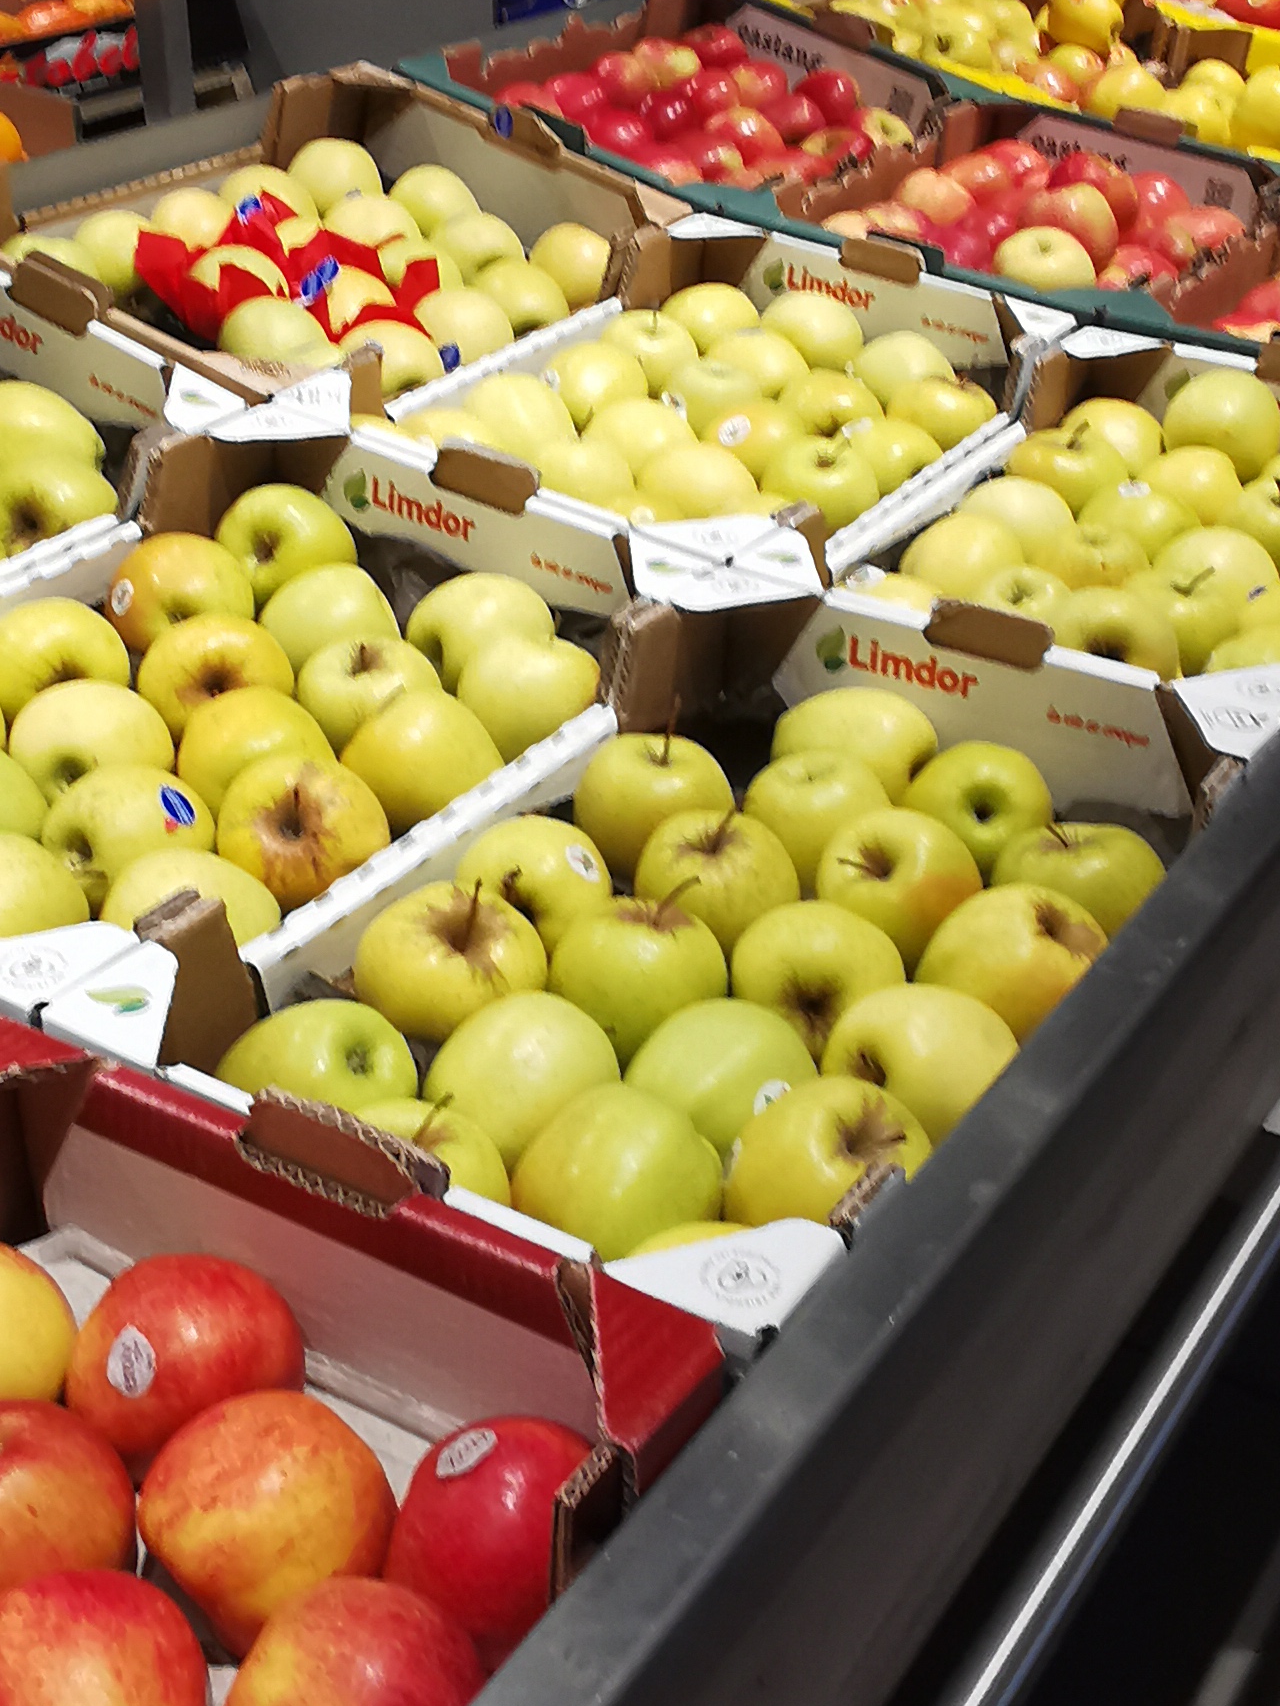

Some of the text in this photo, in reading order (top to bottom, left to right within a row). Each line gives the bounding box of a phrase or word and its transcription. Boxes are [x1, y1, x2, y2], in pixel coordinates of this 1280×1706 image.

[786, 261, 877, 312] Limdor
[371, 475, 477, 543] Limdor
[848, 634, 980, 700] Limdor
